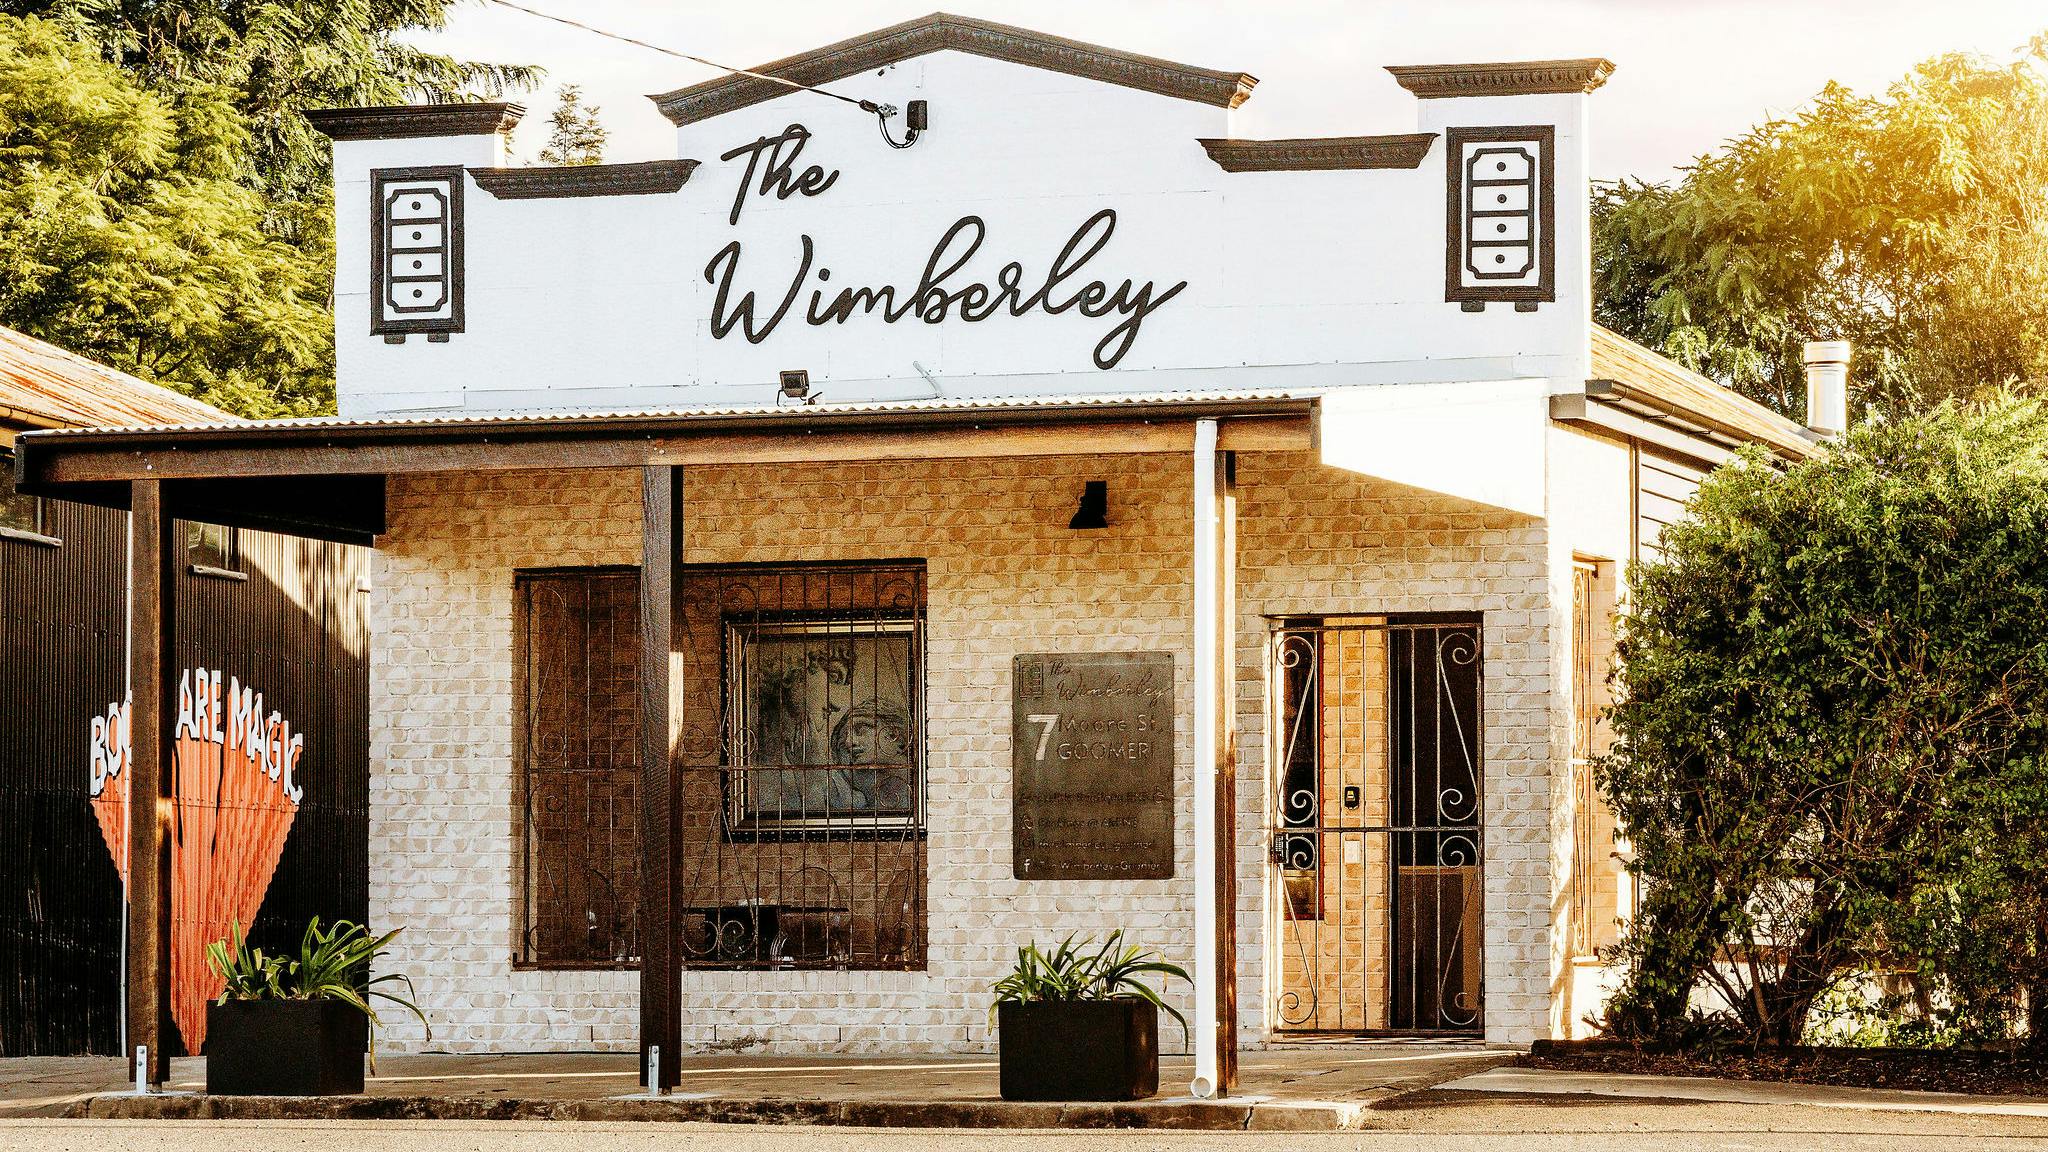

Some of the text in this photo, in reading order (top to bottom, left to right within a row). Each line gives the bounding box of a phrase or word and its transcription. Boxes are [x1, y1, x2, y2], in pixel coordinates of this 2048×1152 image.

[721, 123, 839, 225] The
[704, 208, 1187, 370] Wimberley
[175, 667, 224, 744] ARE
[230, 676, 303, 805] MAGIC
[1026, 713, 1060, 760] 7
[1058, 714, 1127, 732] Moore
[1056, 672, 1174, 707] Wimberley
